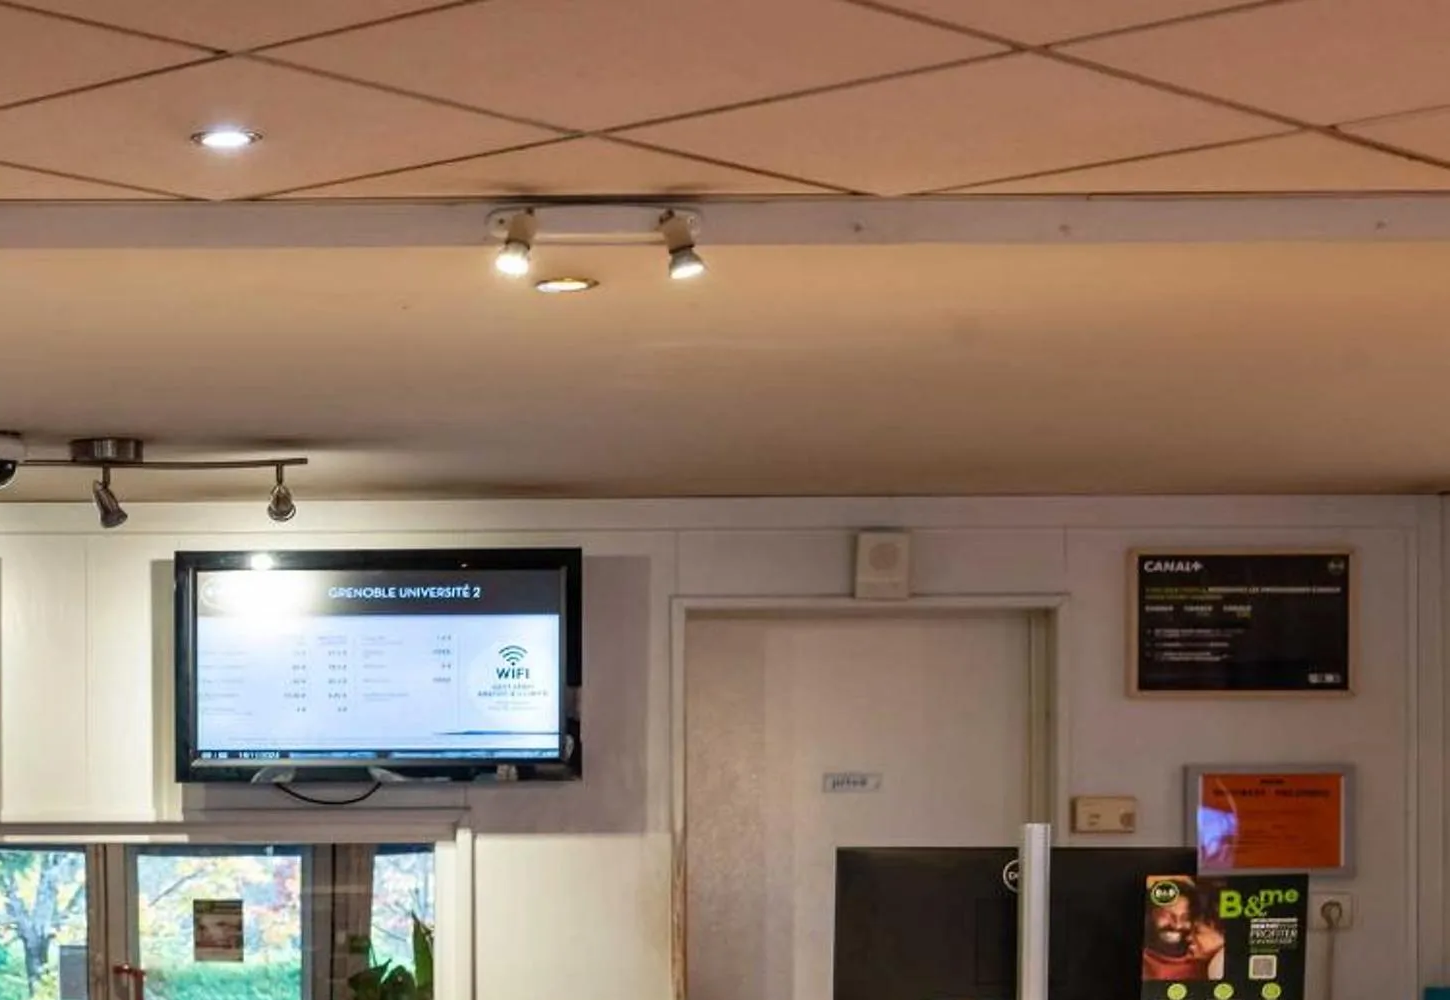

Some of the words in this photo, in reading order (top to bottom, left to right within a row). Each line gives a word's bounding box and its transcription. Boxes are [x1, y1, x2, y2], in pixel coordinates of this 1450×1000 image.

[1144, 561, 1203, 573] CANAL+
[328, 587, 397, 599] GRENOBLE
[399, 583, 469, 599] UNIVERSITÉ
[472, 587, 481, 599] 2
[496, 667, 530, 680] WIFI
[1219, 888, 1299, 918] B&me
